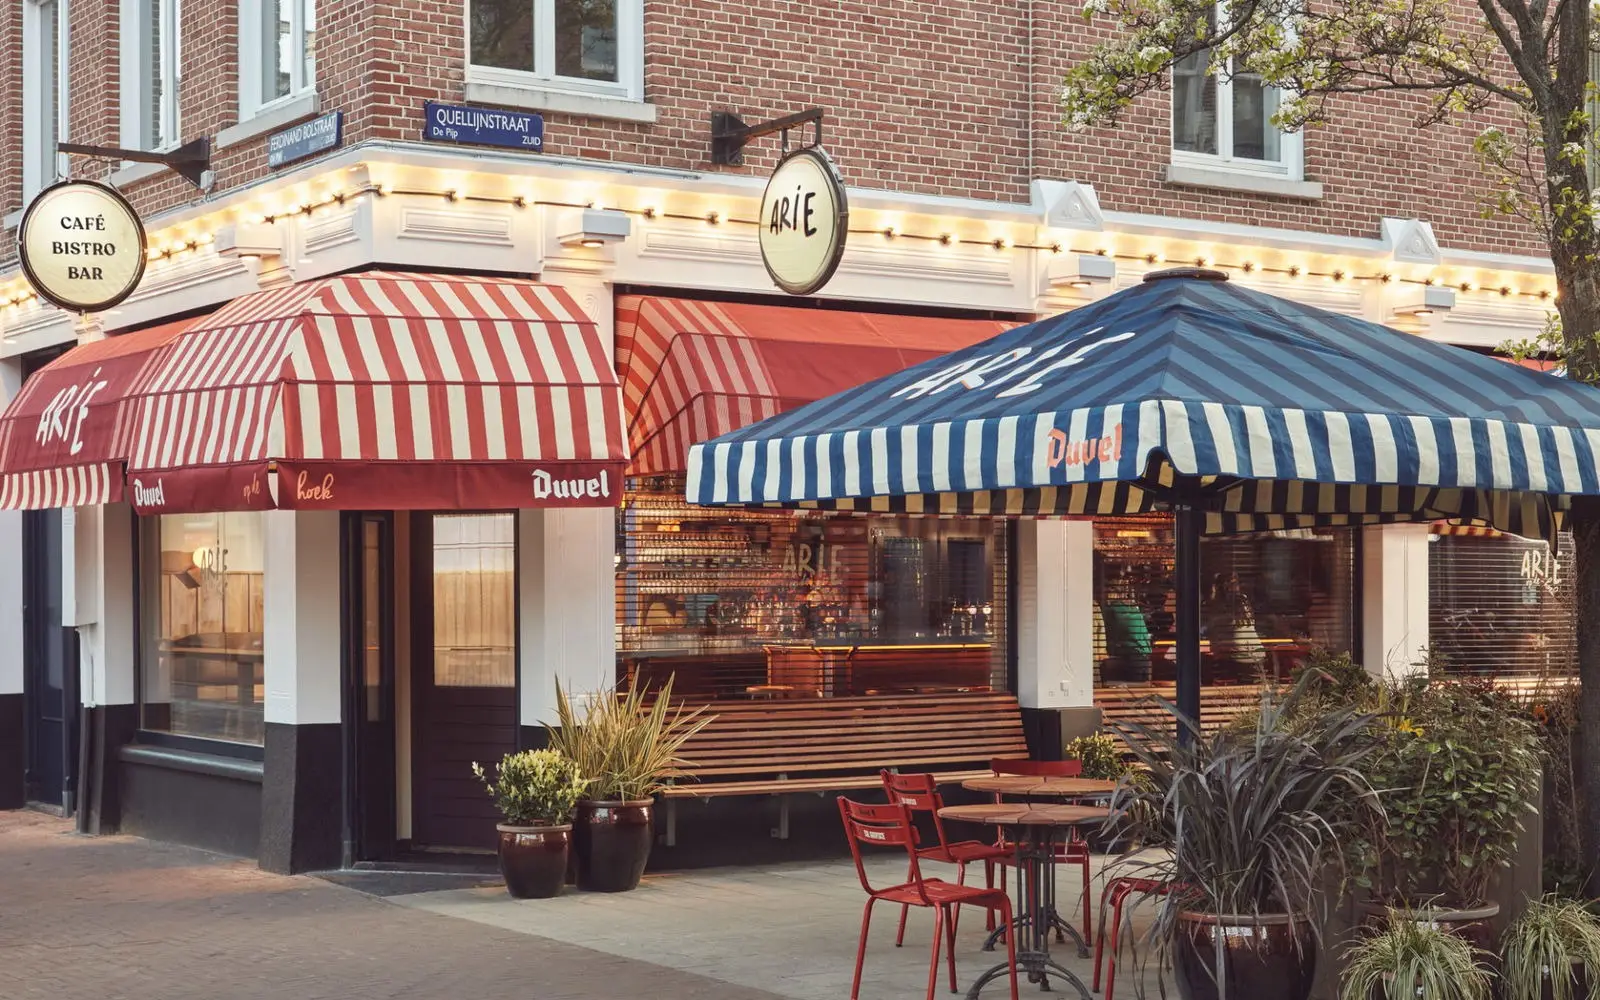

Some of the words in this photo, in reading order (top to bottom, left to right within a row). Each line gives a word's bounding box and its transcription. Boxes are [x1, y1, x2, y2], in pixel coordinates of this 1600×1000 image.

[436, 108, 531, 132] QUELLIJNSTRAAT
[432, 126, 444, 136] De
[522, 135, 541, 146] ZUID
[60, 213, 106, 231] CAFÉ
[52, 241, 116, 256] BISTRO
[67, 266, 104, 280] BAR
[1046, 422, 1123, 469] Duvel
[133, 477, 165, 507] Duvel
[296, 470, 334, 500] hoek
[531, 468, 611, 500] Duvel
